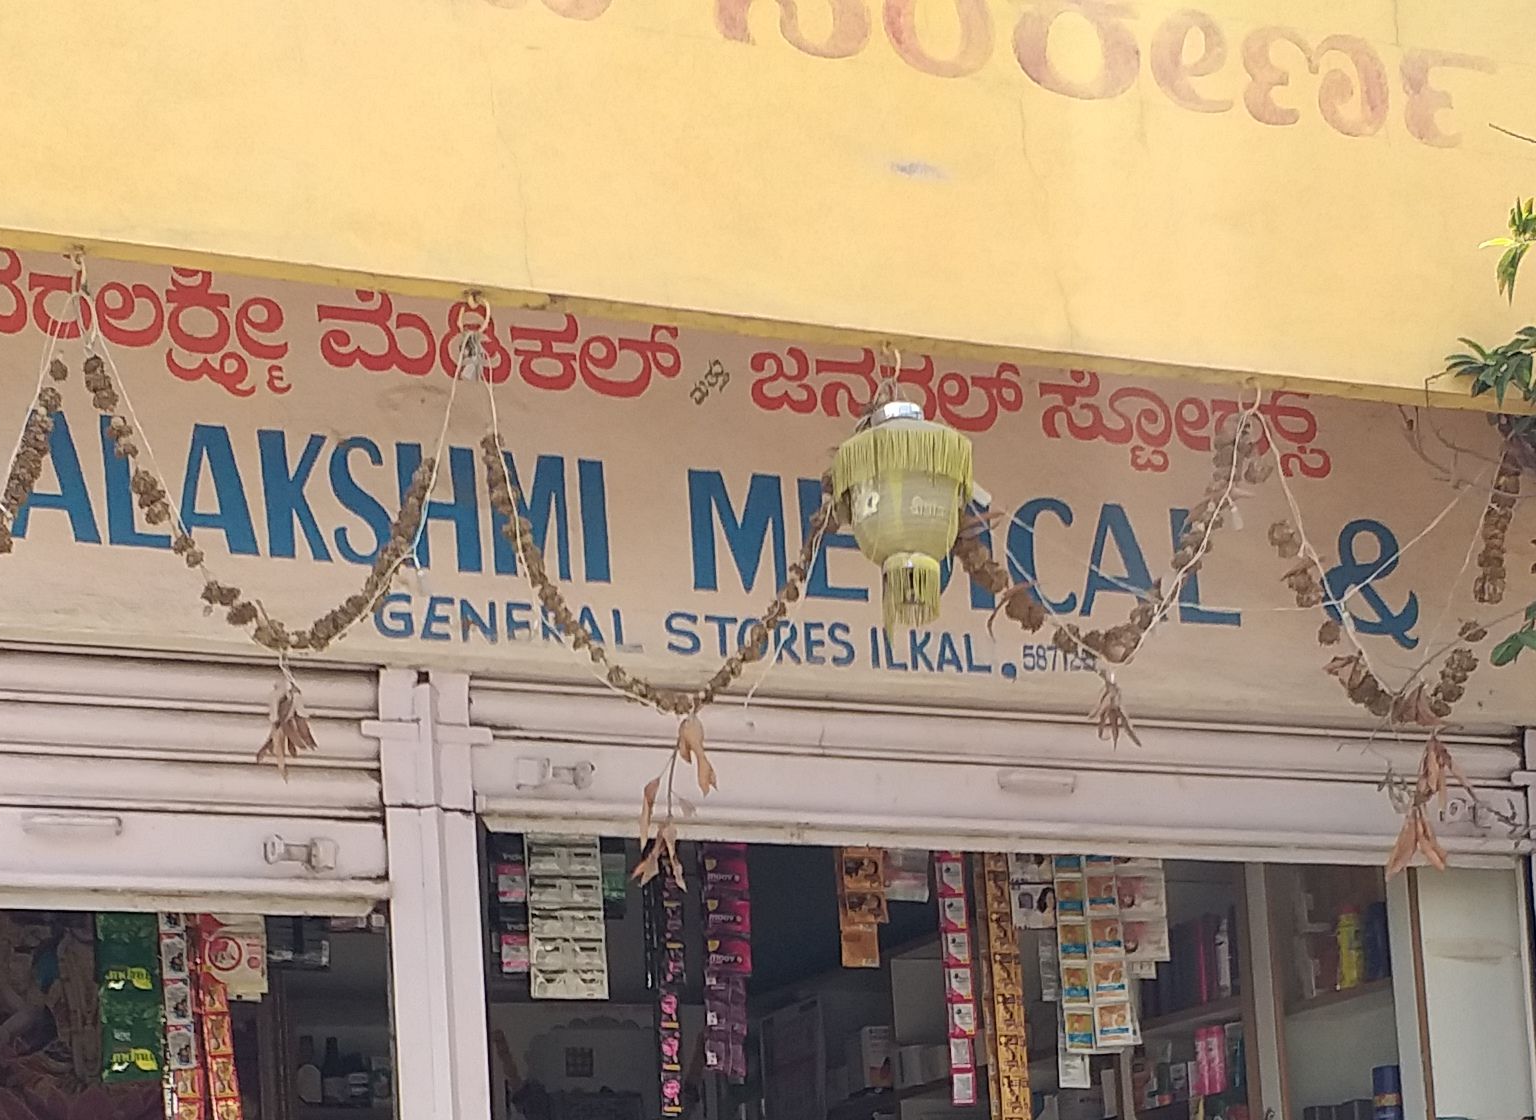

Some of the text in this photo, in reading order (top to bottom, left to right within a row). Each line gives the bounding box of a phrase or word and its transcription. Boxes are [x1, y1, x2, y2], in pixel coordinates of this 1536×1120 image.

[686, 468, 1242, 627] MEICAL
[1323, 518, 1420, 651] &
[372, 594, 644, 655] GENERAL
[664, 612, 857, 669] STORES
